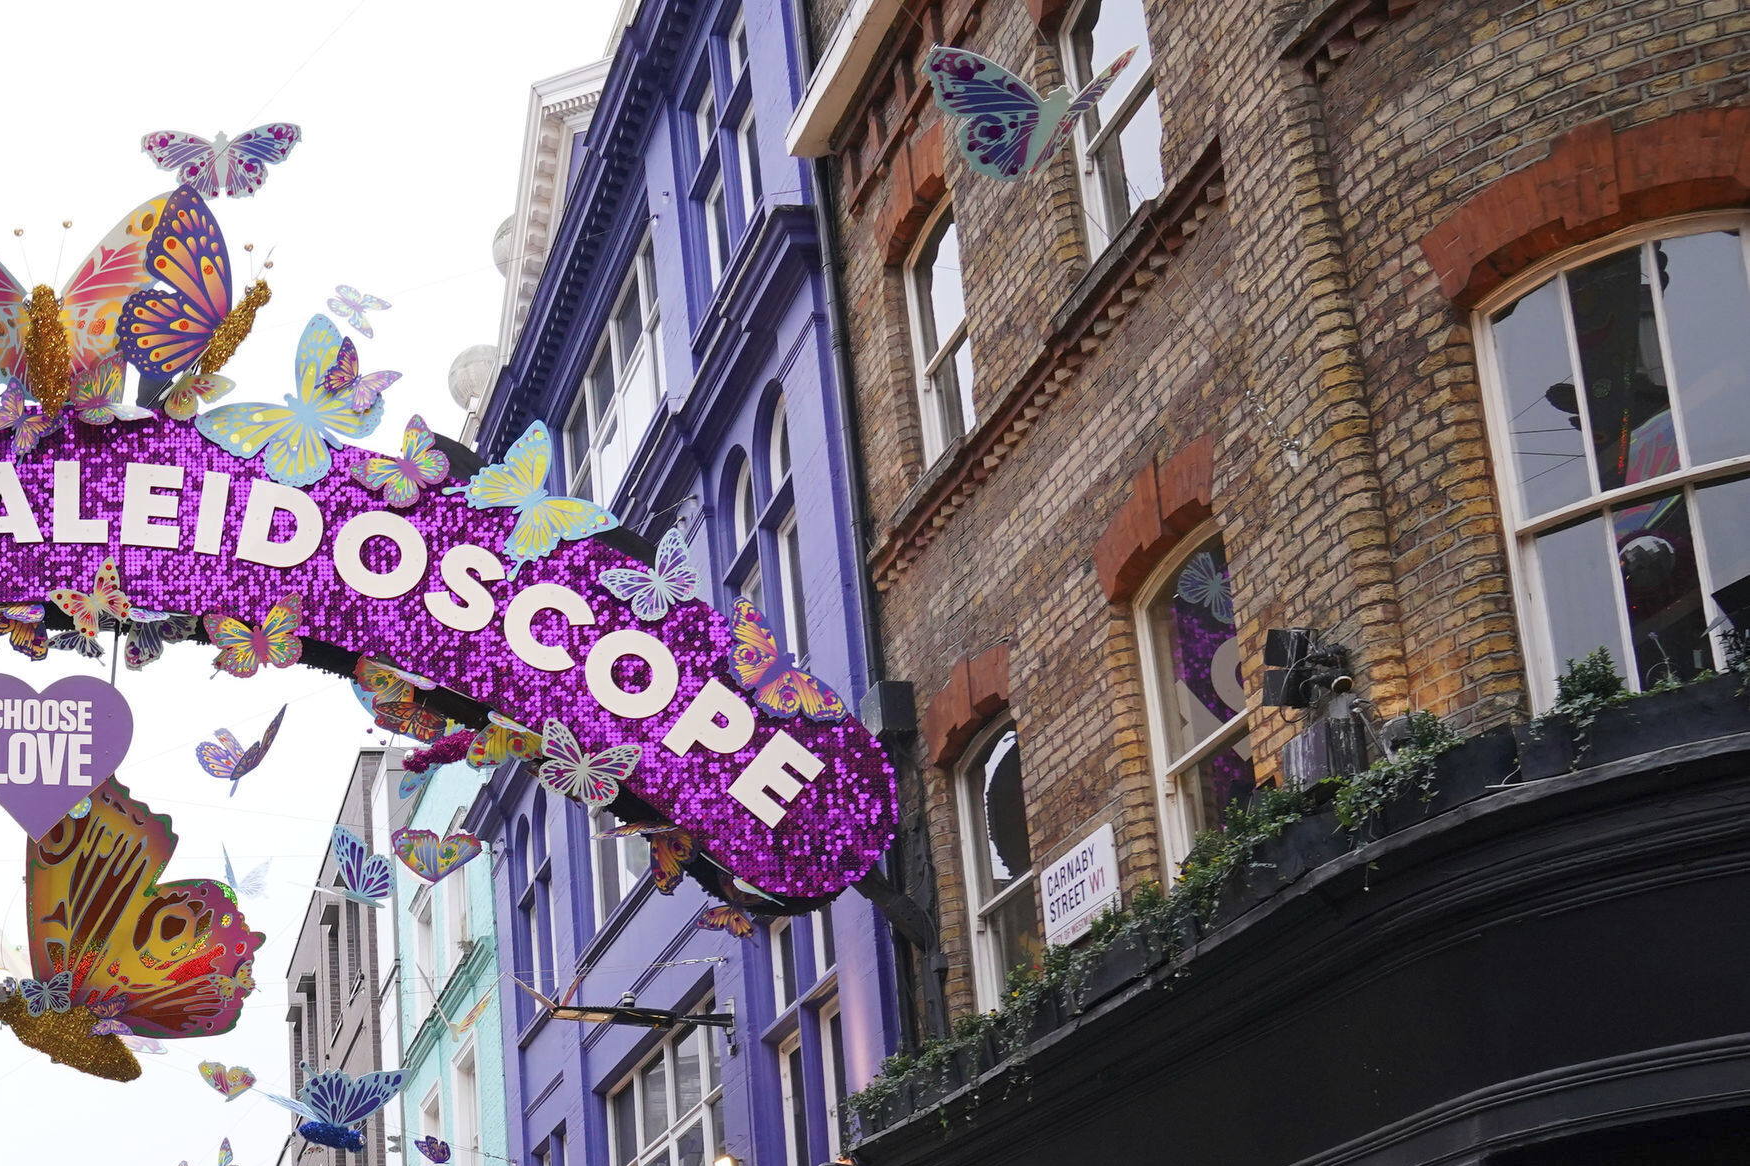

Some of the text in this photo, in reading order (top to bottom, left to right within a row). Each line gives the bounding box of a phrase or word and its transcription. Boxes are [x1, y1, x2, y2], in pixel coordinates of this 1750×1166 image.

[1047, 843, 1095, 897] CARNABY
[1049, 866, 1106, 923] STREET W1
